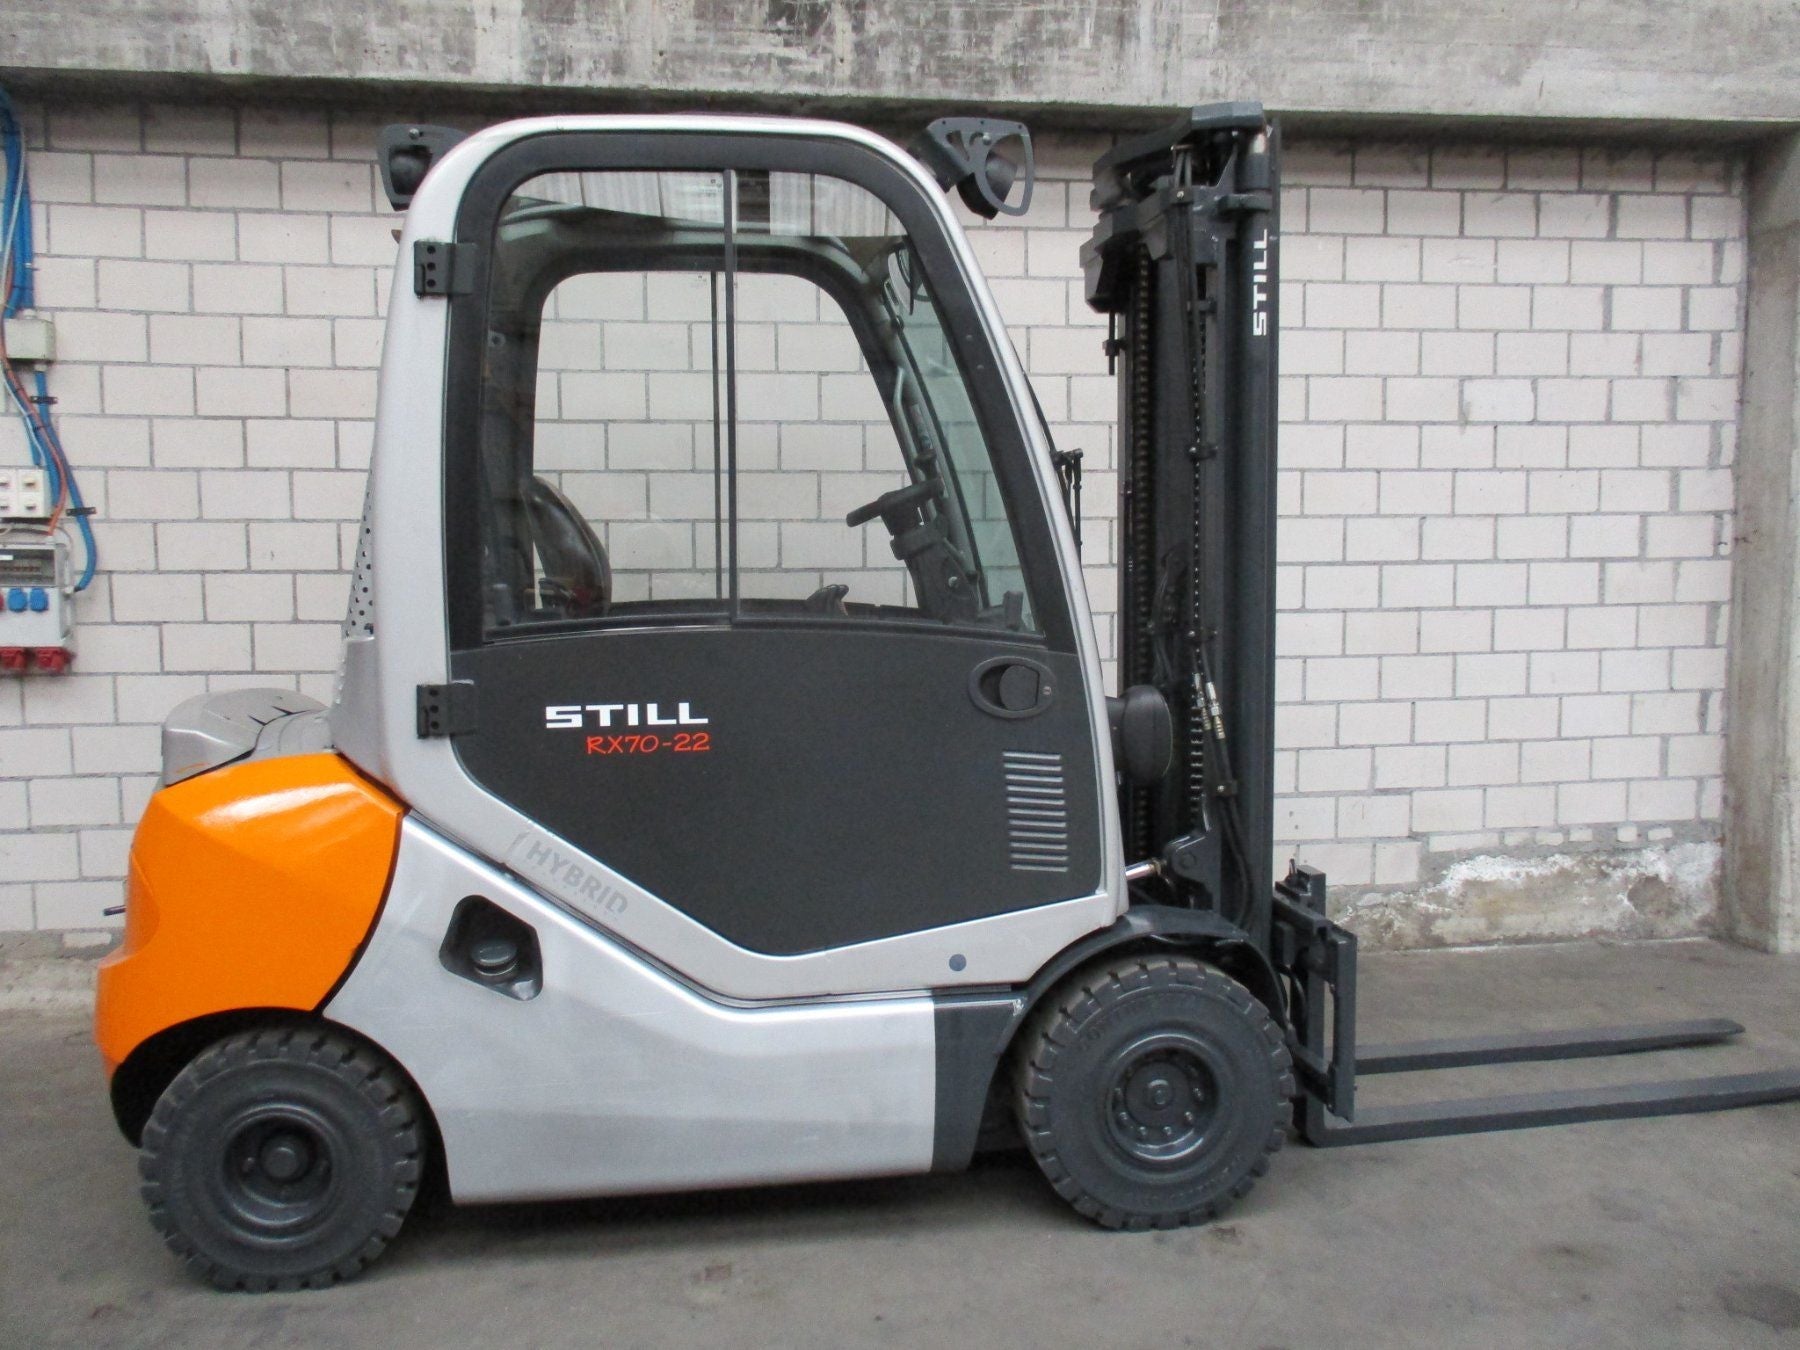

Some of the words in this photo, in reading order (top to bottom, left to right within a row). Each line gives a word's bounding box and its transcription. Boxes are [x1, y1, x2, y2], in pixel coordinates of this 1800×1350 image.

[1252, 228, 1267, 336] STILL
[545, 702, 709, 729] STILL
[586, 732, 711, 755] RX70-22
[526, 840, 629, 914] HYBRID
